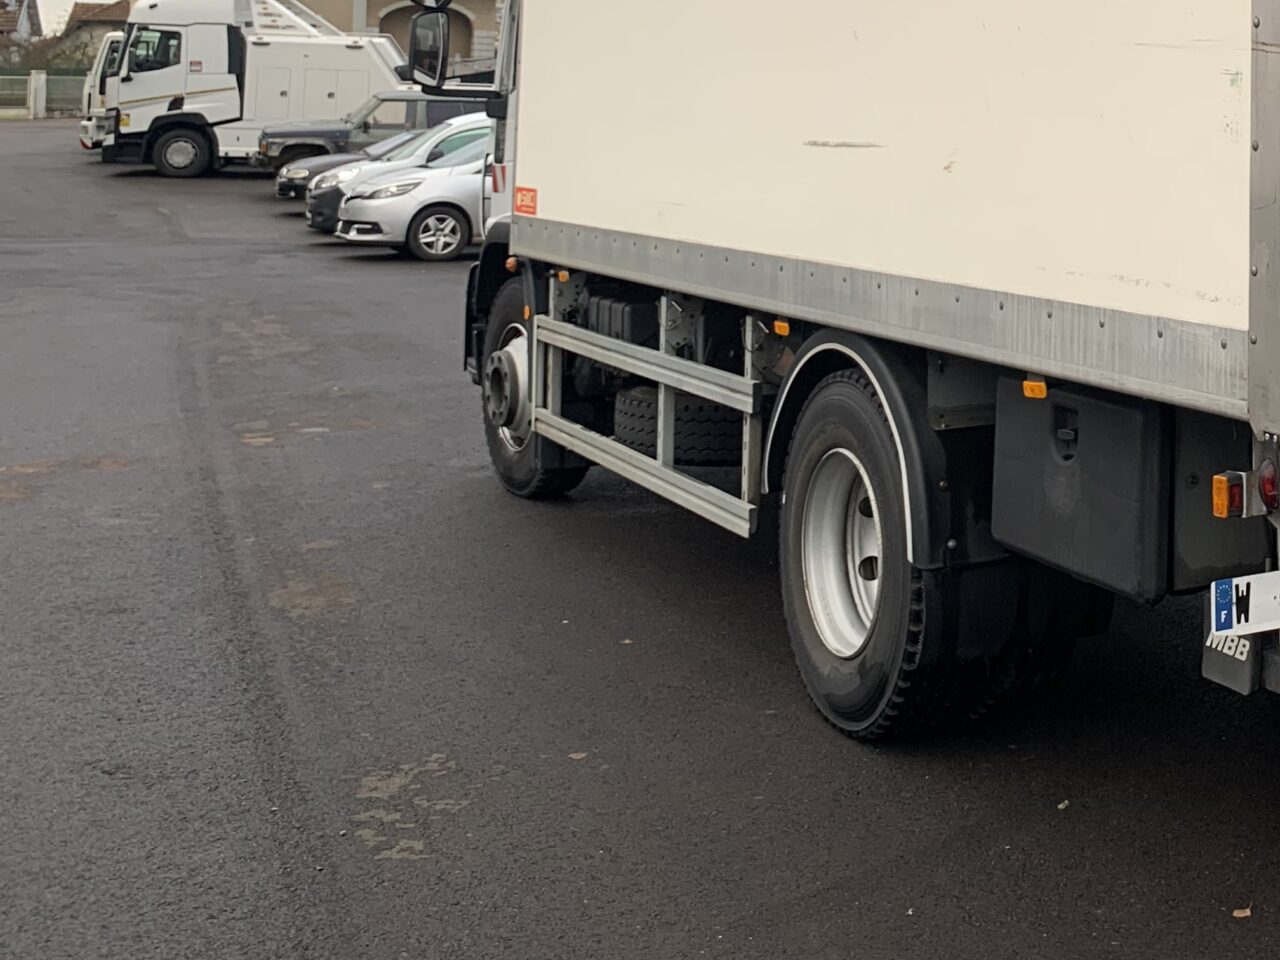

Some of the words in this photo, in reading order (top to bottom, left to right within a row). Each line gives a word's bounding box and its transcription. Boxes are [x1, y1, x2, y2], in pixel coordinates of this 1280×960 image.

[1221, 610, 1228, 622] F
[1234, 582, 1251, 625] W
[1205, 632, 1250, 661] MBB
